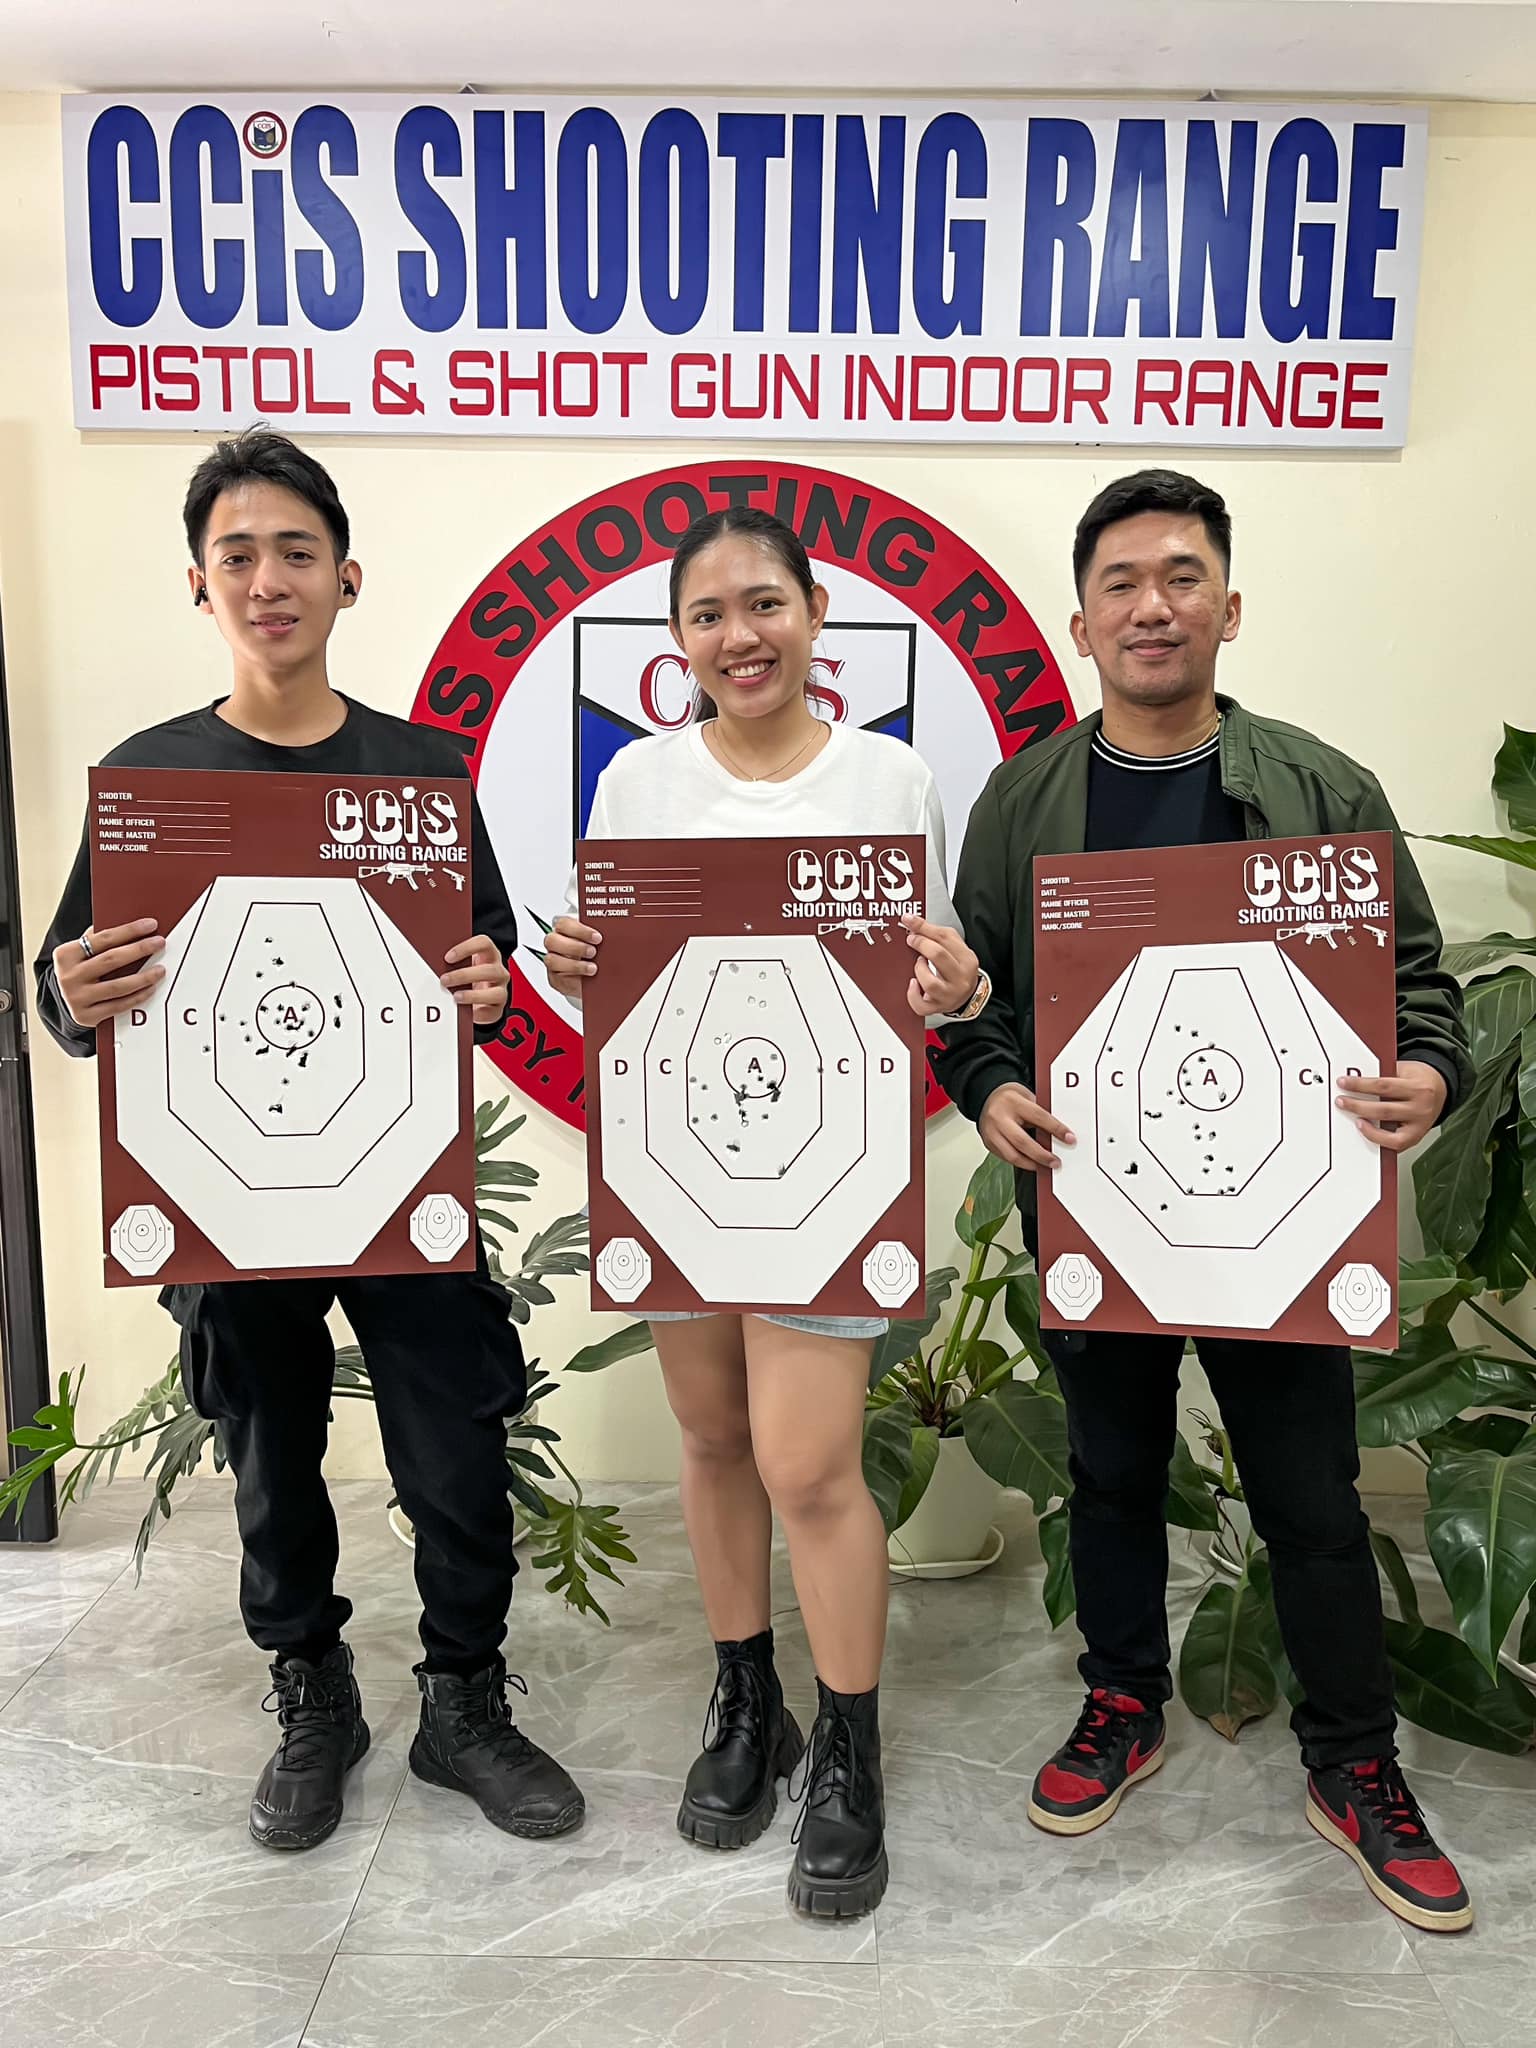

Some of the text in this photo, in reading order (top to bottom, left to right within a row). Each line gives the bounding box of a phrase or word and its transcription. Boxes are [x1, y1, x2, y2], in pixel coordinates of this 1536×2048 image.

[395, 106, 987, 339] SHOOTING
[1020, 118, 1405, 343] RANGE
[90, 345, 1388, 429] PISTOL & SHOT GUN INDOOR RANGE
[470, 475, 936, 658] SHOOTING
[931, 569, 1066, 757] RAN
[97, 791, 132, 801] SHOOTER
[98, 804, 117, 813] DATE
[98, 817, 154, 827] RANGE OFFICER
[99, 830, 156, 840] RANGE MASTER
[99, 843, 148, 852] RANK/SCORE
[320, 844, 467, 863] SHOOTING RANGE
[584, 861, 614, 870] SHOOTER
[584, 873, 601, 882] DATE
[1040, 876, 1070, 886] SHOOTER
[585, 885, 634, 894] RANGE OFFICER
[1040, 888, 1056, 897] DATE
[585, 897, 635, 905] RANGE MASTER
[1040, 898, 1088, 908] RANGE OFFICER
[586, 908, 628, 917] RANK/SCORE
[782, 901, 922, 918] SHOOTING RANGE
[1041, 909, 1090, 920] RANGE MASTER
[1238, 902, 1390, 925] SHOOTING RANGE
[131, 1006, 440, 1026] D C A C D
[615, 1058, 893, 1075] D C A C D
[1066, 1072, 1079, 1087] D
[1111, 1071, 1123, 1087] C
[1203, 1069, 1217, 1085] A
[1299, 1069, 1312, 1085] C
